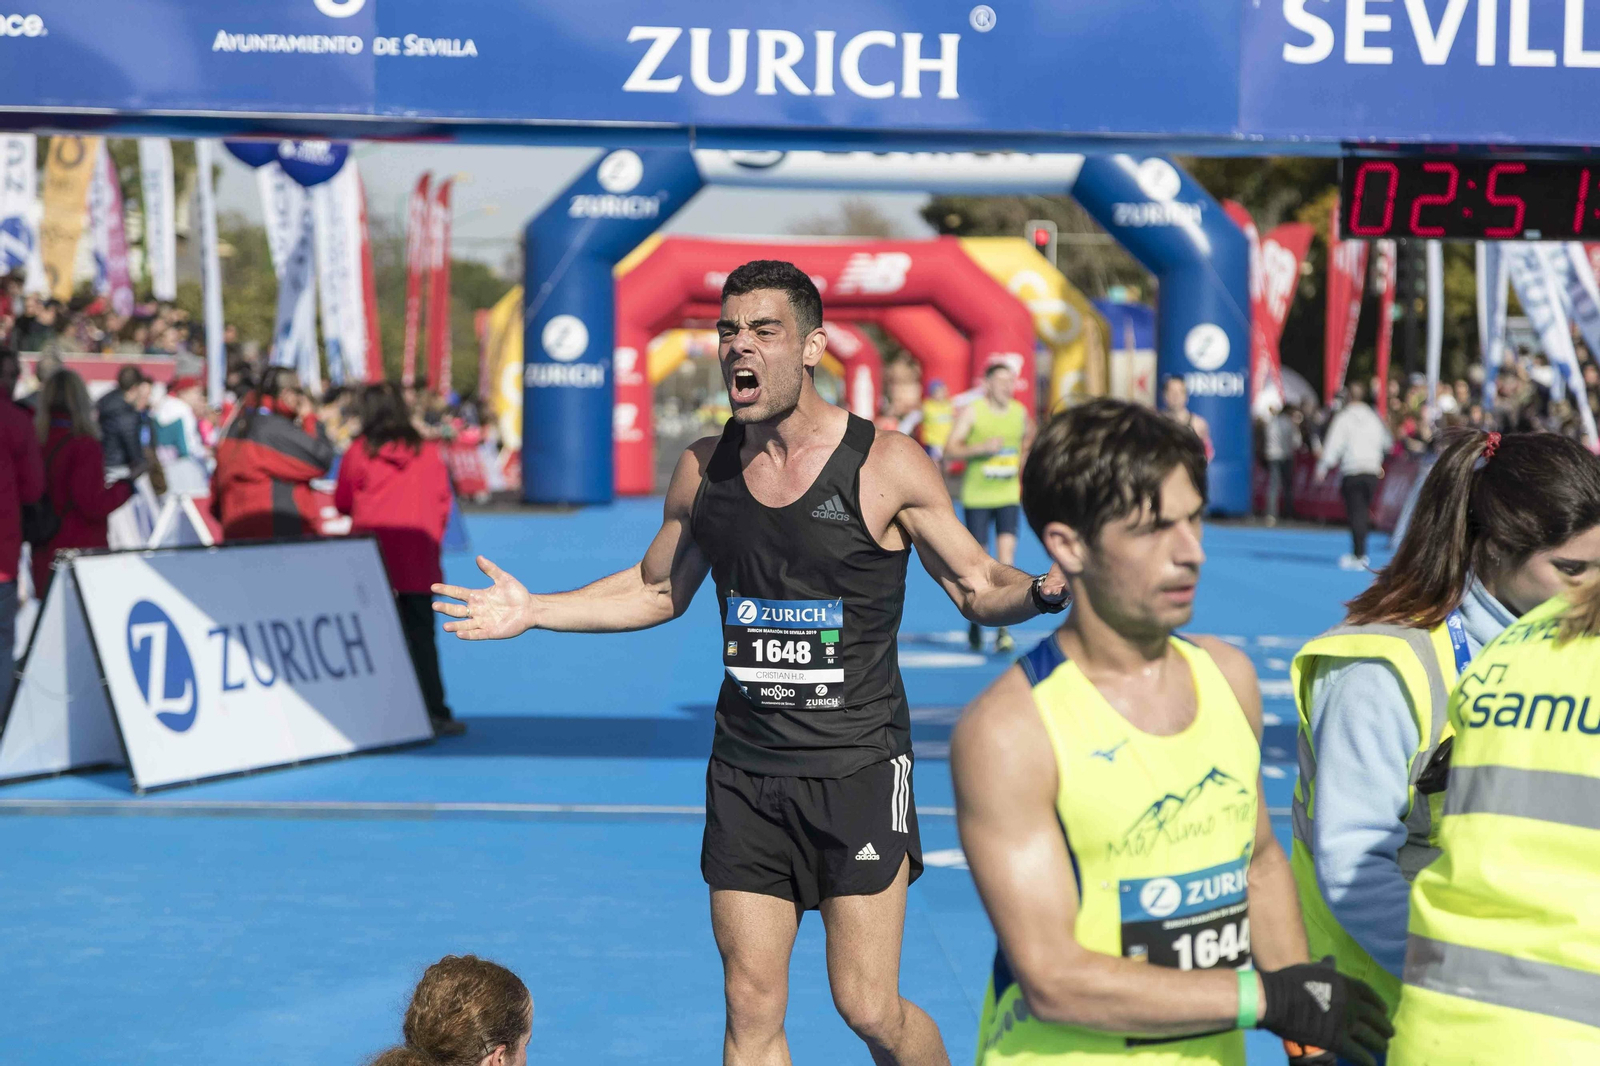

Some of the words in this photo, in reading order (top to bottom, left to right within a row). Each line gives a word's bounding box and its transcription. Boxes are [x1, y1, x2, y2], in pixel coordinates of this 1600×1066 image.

[212, 30, 363, 55] AYUNTAMIENTO
[373, 37, 400, 56] DE
[403, 33, 478, 57] SEVILLA
[622, 26, 960, 99] ZURICH
[568, 194, 660, 219] ZURICH
[812, 509, 850, 522] adidas
[761, 607, 826, 622] ZURICH
[208, 612, 376, 692] ZURICH
[752, 639, 812, 664] 1648
[756, 671, 790, 680] CRISTIAN
[805, 698, 838, 706] ZURICH
[855, 853, 880, 861] adidas
